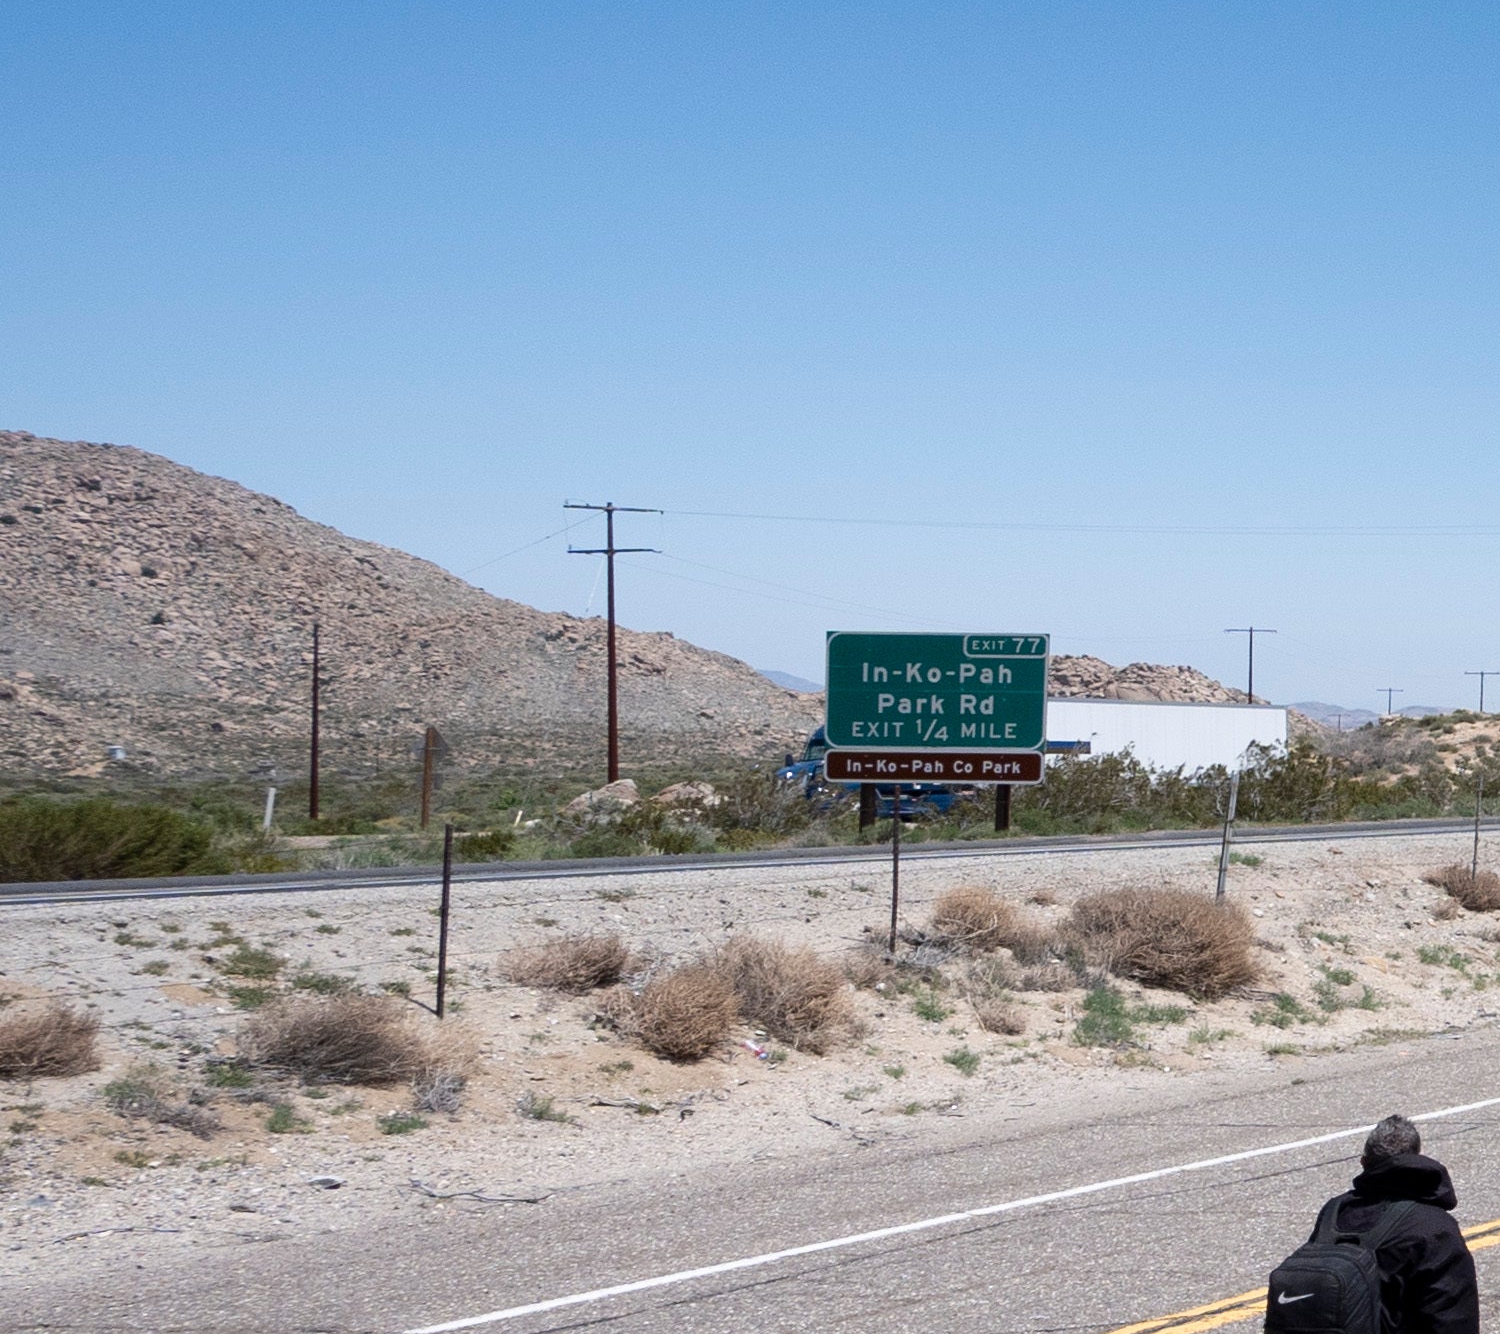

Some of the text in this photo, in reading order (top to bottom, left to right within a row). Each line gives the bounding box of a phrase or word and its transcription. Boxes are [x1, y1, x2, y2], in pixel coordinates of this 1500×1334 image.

[971, 637, 1041, 654] EXIT 77
[861, 662, 1013, 684] In-Ko-Pah
[877, 693, 995, 715] Park Rd
[851, 719, 1018, 742] EXIT 1/4 MILE
[846, 759, 1022, 774] In-Ko-Pah Co Park
